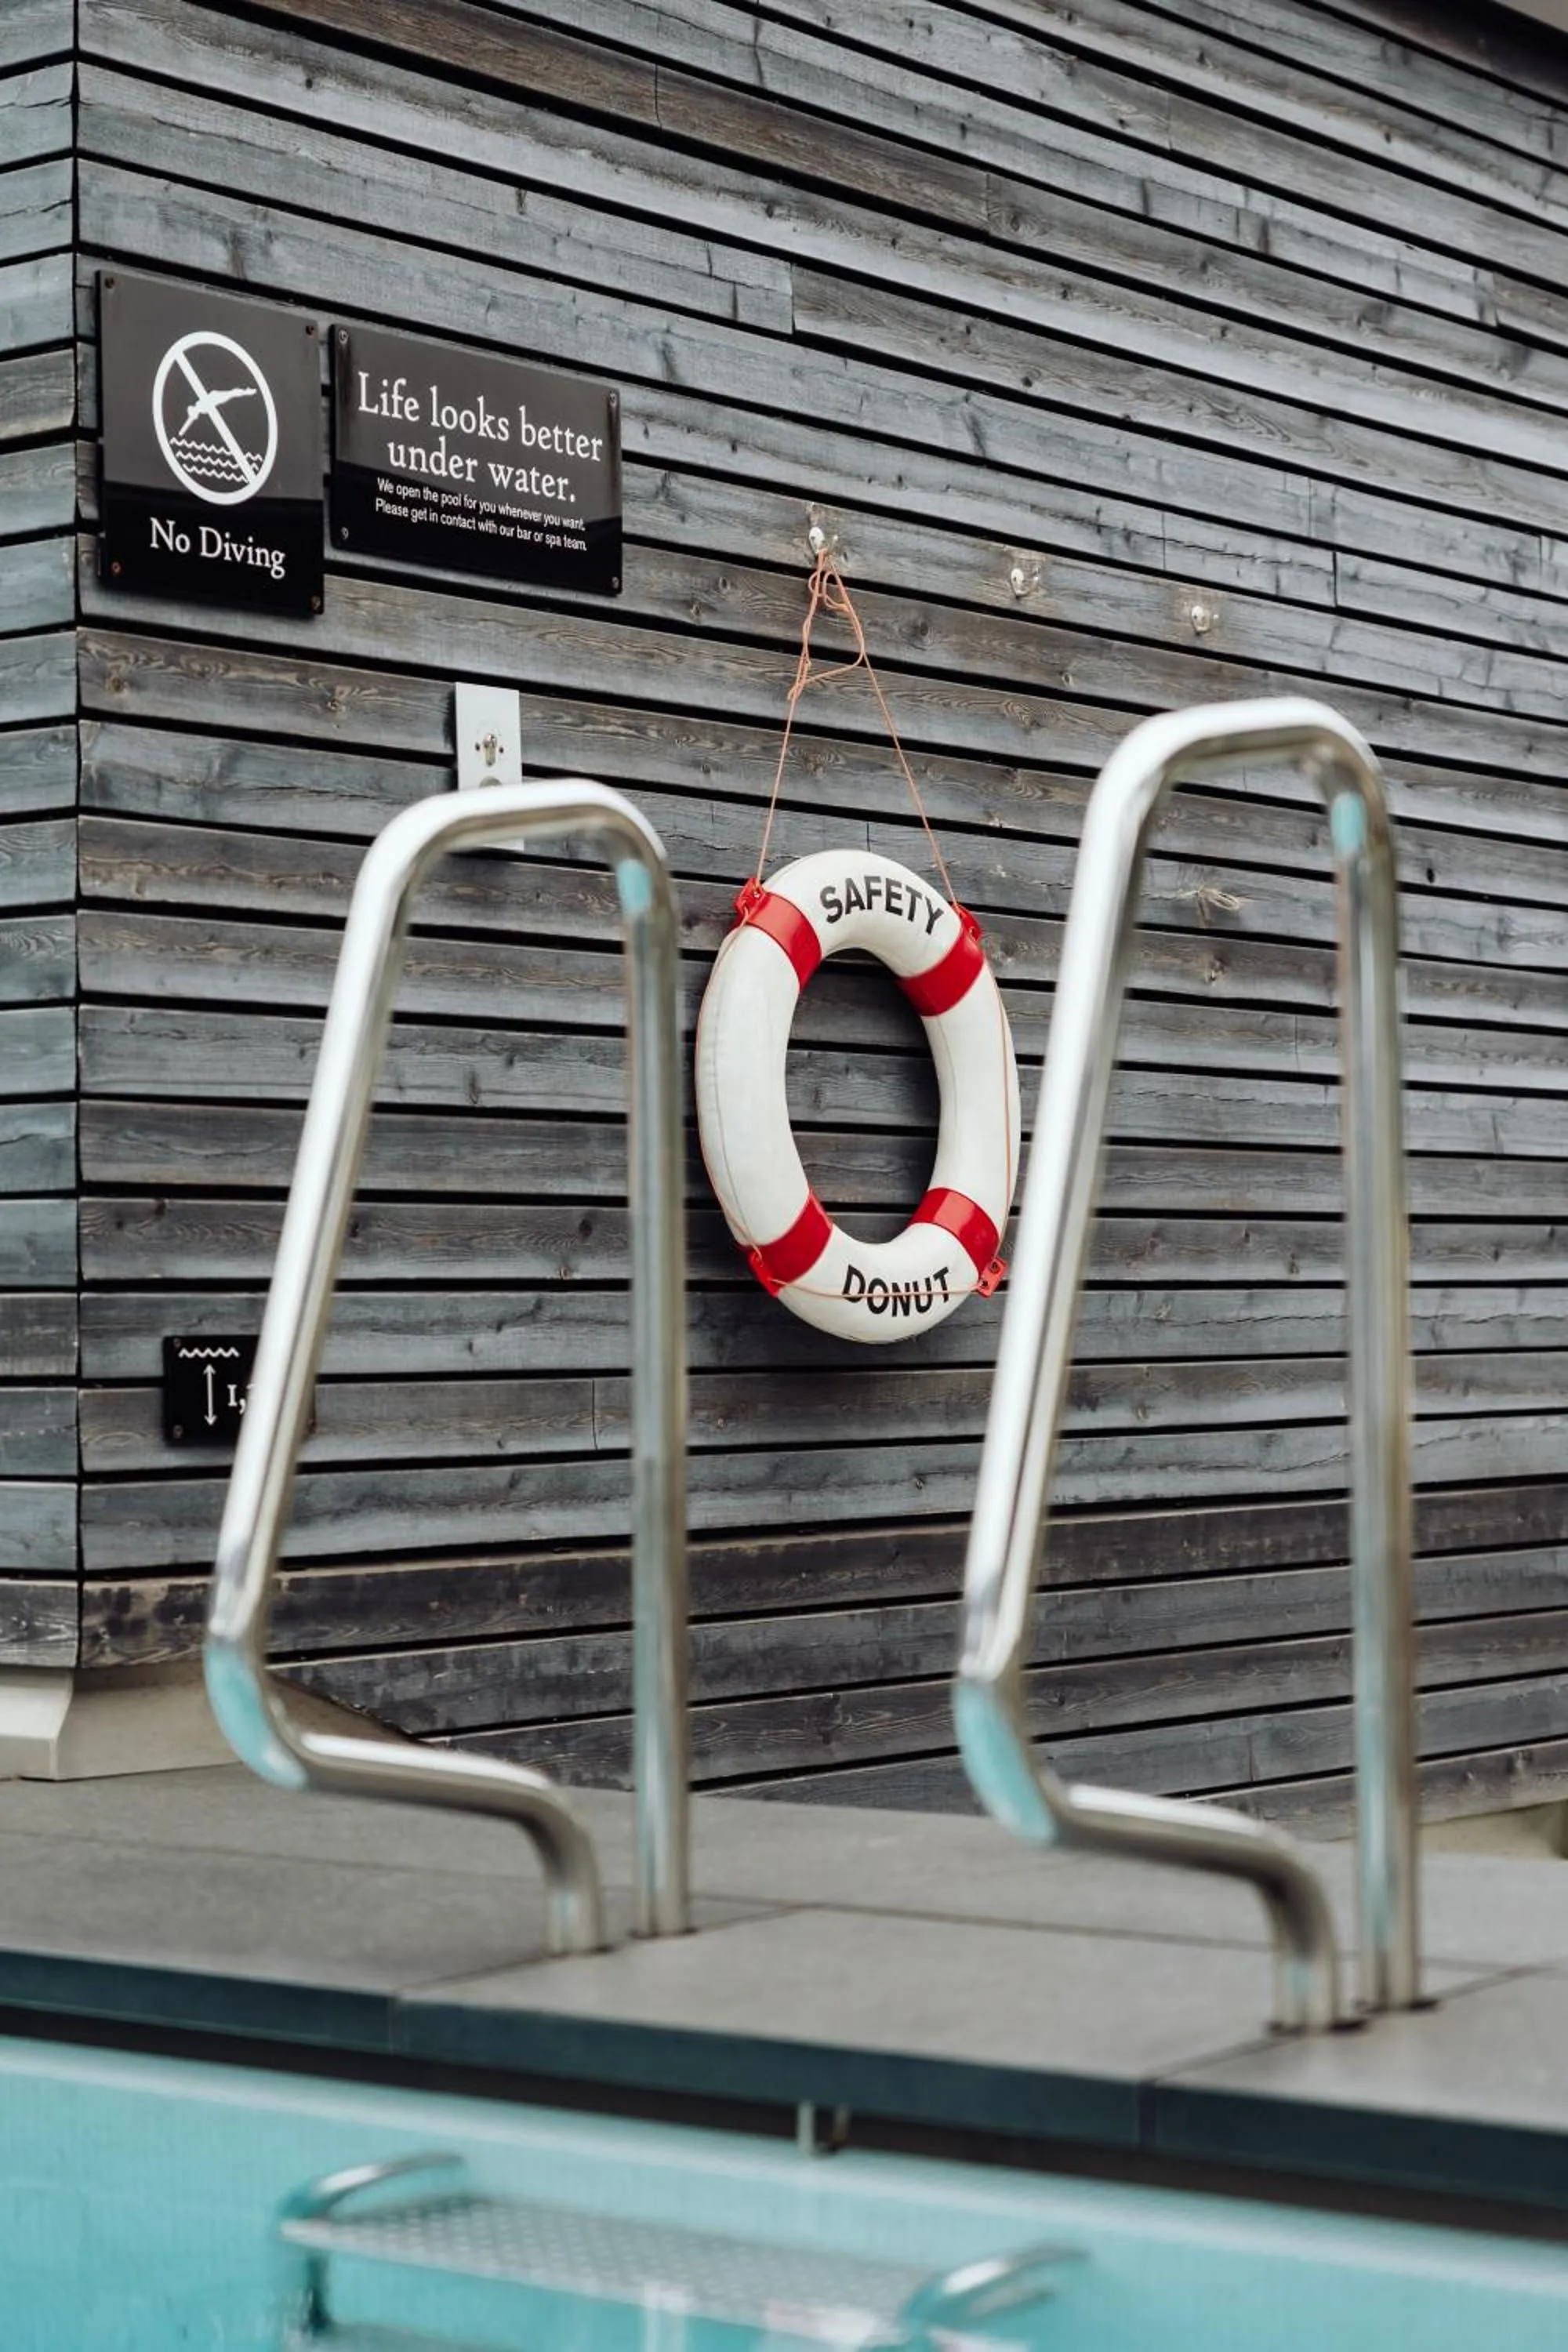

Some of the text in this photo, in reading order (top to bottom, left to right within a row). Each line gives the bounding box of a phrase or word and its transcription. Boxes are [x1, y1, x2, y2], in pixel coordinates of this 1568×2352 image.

[358, 371, 603, 462] Life looks better
[387, 436, 576, 503] under water.
[376, 497, 587, 551] Please get in contact with our bar or spa team.
[377, 477, 586, 532] We open the pool for you whenever you want.
[150, 517, 286, 579] No Diving
[819, 875, 945, 935] SAFETY
[841, 1264, 949, 1318] DONUT
